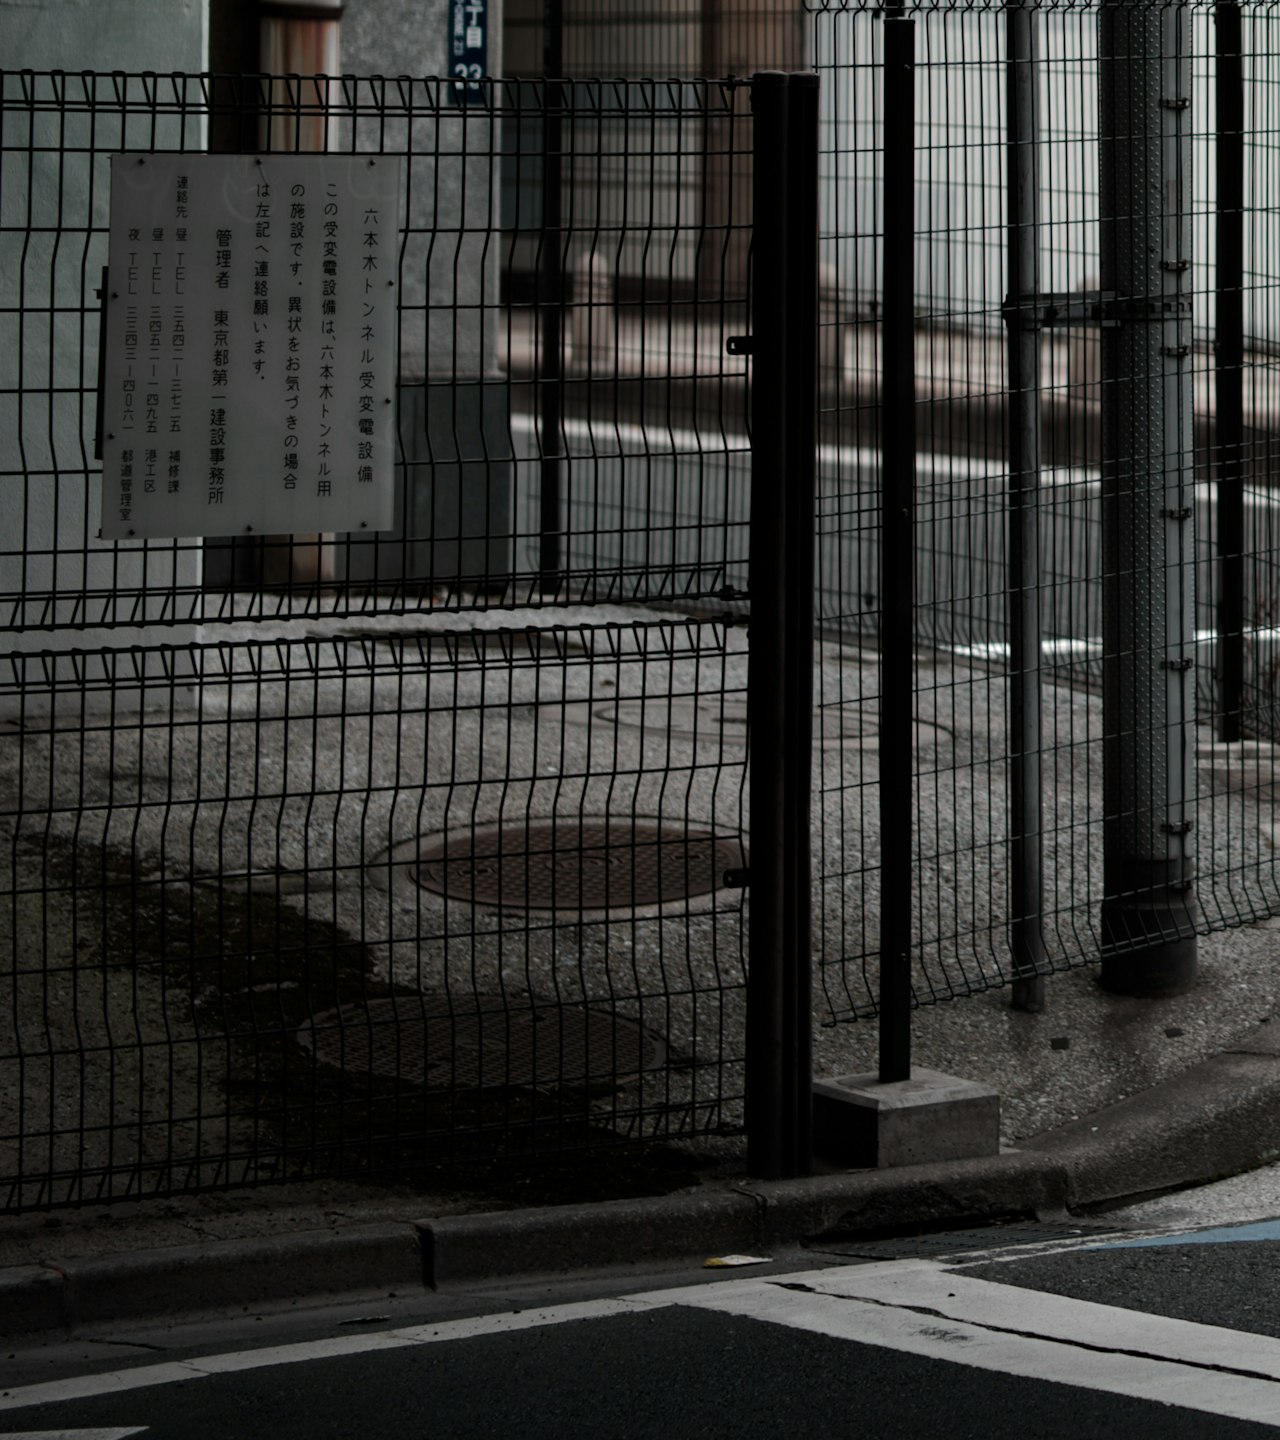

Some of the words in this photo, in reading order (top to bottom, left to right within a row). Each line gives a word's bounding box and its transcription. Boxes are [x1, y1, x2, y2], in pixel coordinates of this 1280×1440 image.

[176, 176, 188, 218] 連絡先
[128, 229, 140, 241] 夜
[152, 228, 163, 241] 昼
[176, 228, 187, 241] 昼
[128, 253, 138, 294] TEL
[152, 253, 162, 294] TEL
[176, 253, 185, 294] TEL
[215, 229, 232, 288] 管理者
[317, 184, 338, 496] この受変電設備は、六本木トンネル用
[358, 208, 378, 482] 六本木トンネル受変電設備
[208, 310, 229, 504] 東京都第一建設事務所
[119, 450, 133, 521] 都道管理室
[144, 449, 157, 492] 港工区
[168, 450, 180, 493] 補修課
